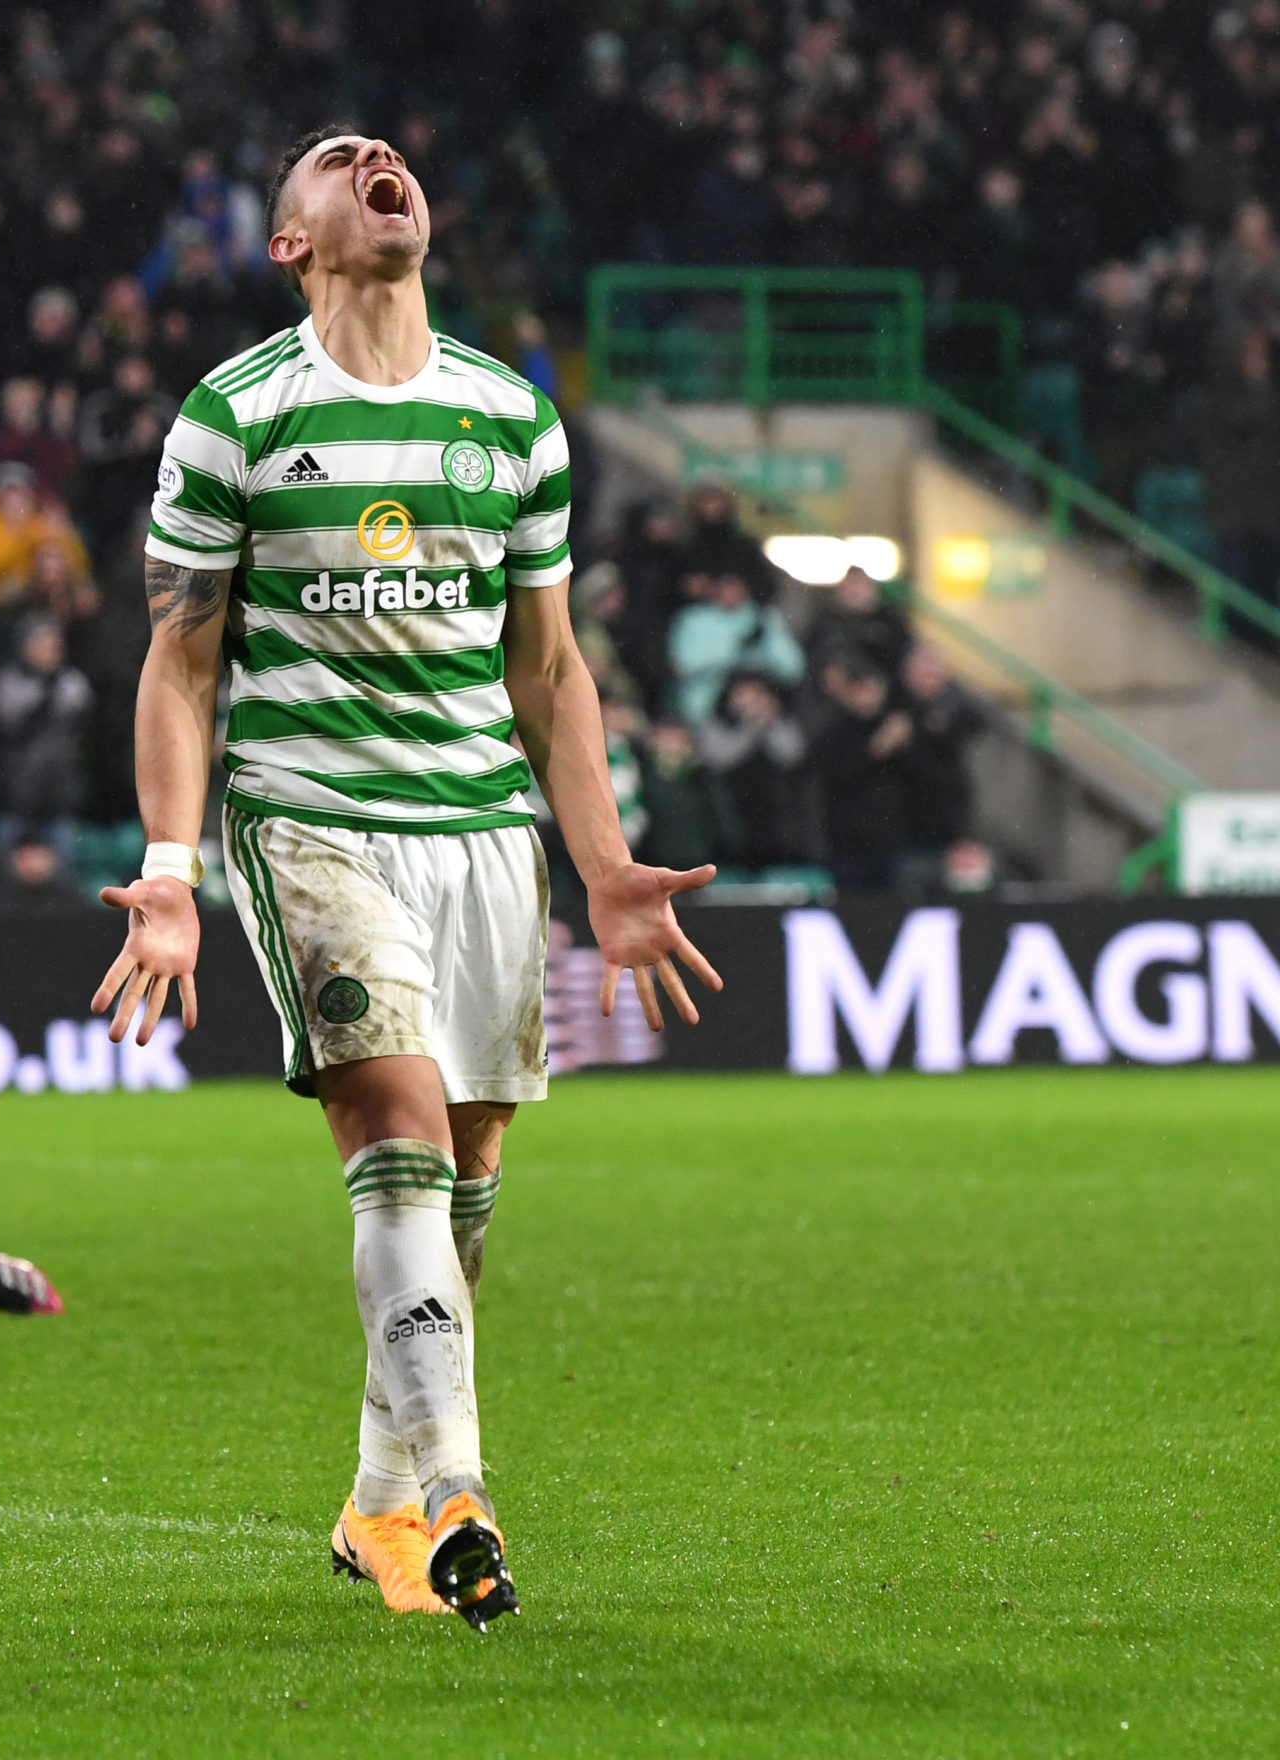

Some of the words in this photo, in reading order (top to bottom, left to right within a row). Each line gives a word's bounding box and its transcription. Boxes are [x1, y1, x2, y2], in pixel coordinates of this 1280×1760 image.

[281, 470, 329, 483] adidas
[300, 567, 470, 620] dafabet
[781, 905, 1280, 1075] MAGN
[387, 1319, 463, 1343] adidas
